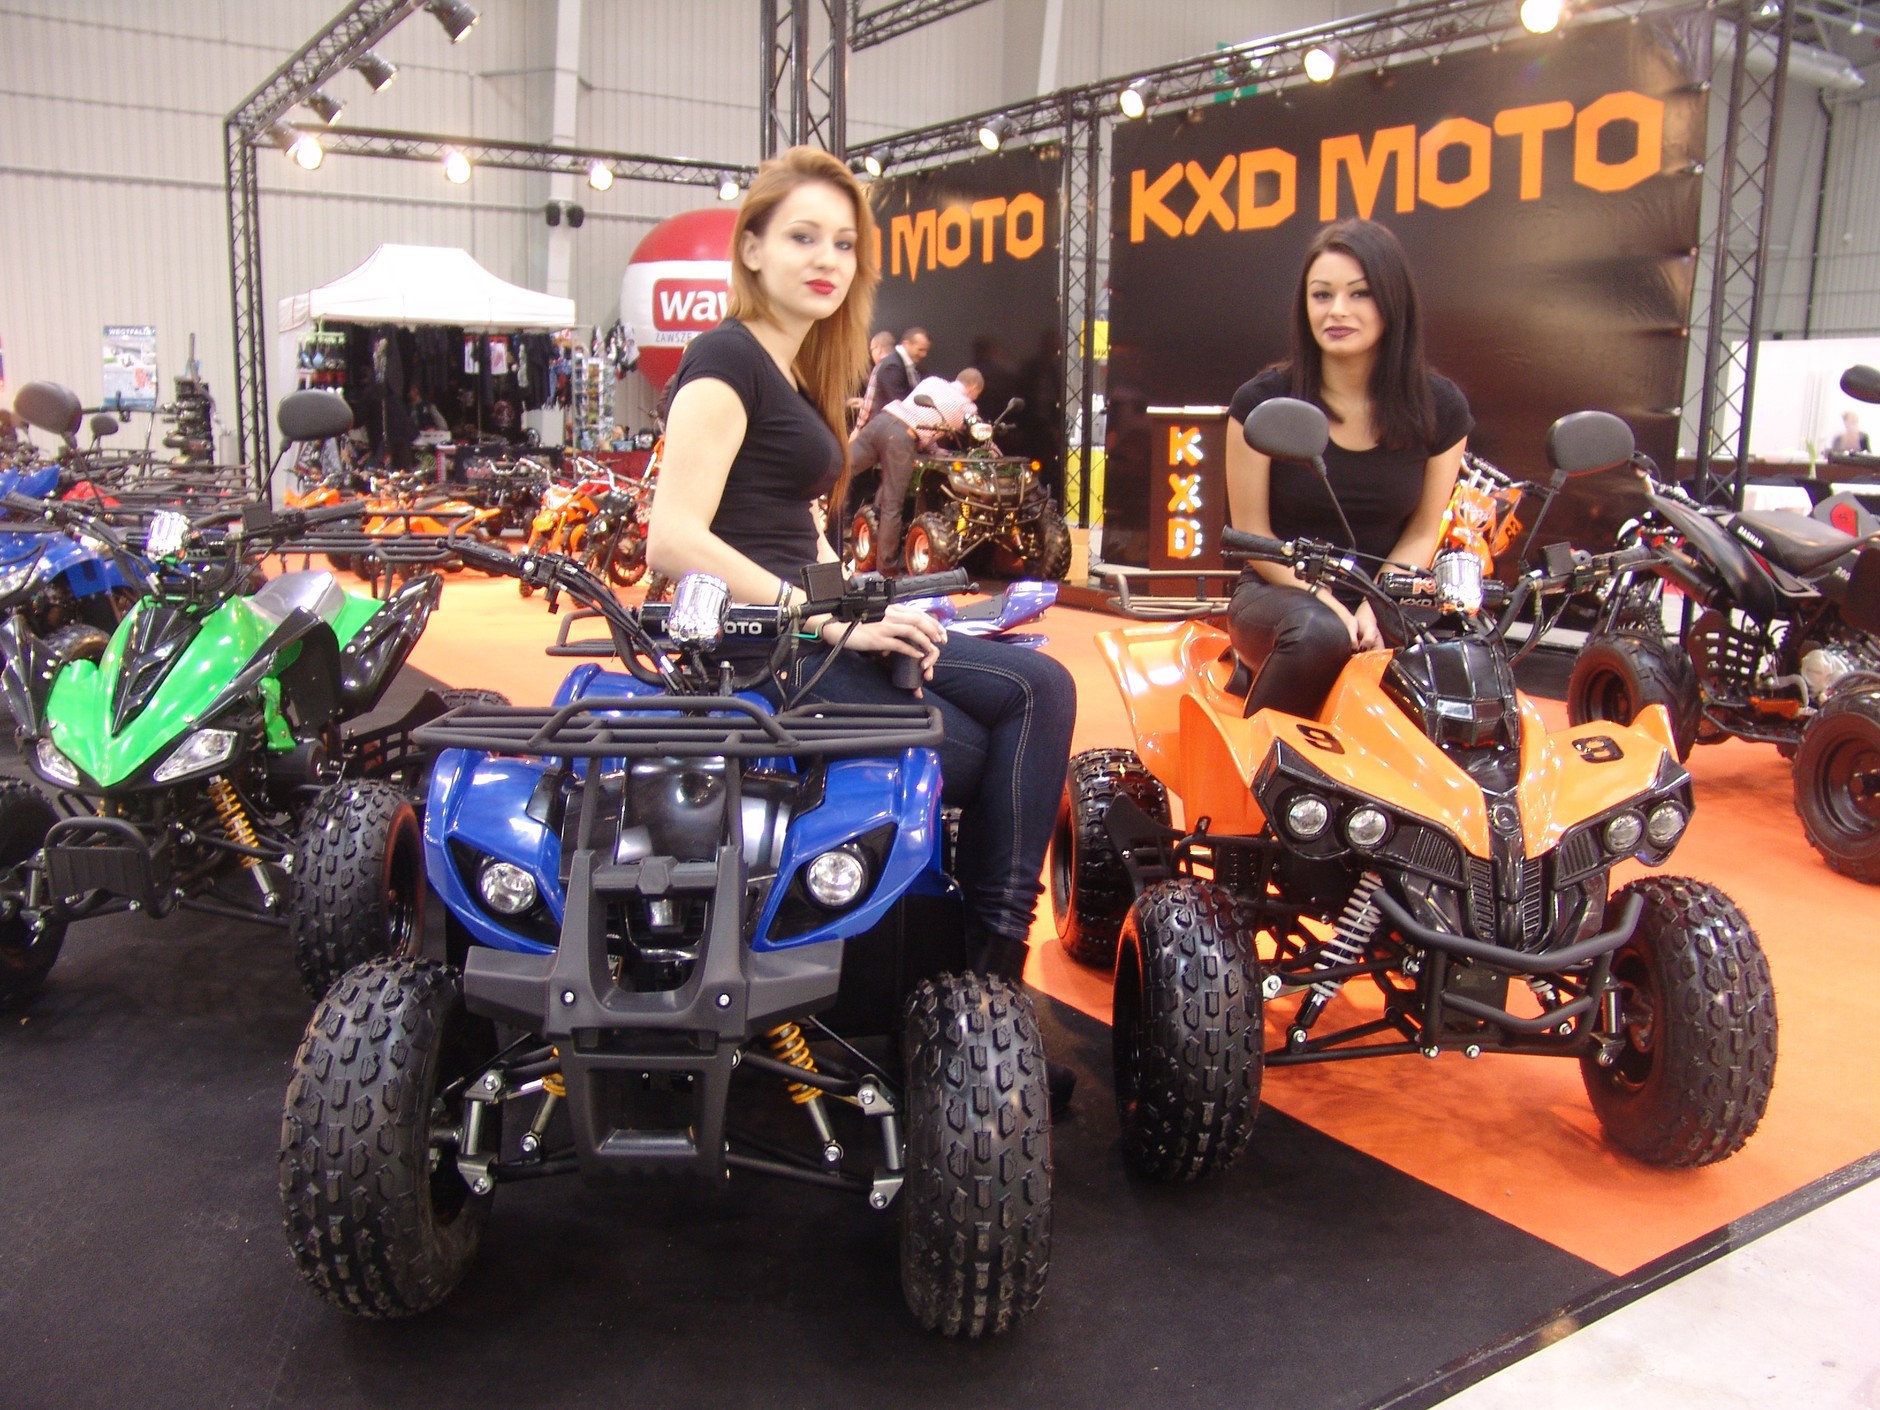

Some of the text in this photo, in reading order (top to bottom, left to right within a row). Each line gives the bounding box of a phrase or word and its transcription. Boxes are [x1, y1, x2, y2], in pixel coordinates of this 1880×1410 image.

[1130, 90, 1665, 243] KXD MOTO
[891, 192, 1044, 283] MOTO
[1167, 426, 1203, 559] KXD
[723, 621, 762, 634] OTO
